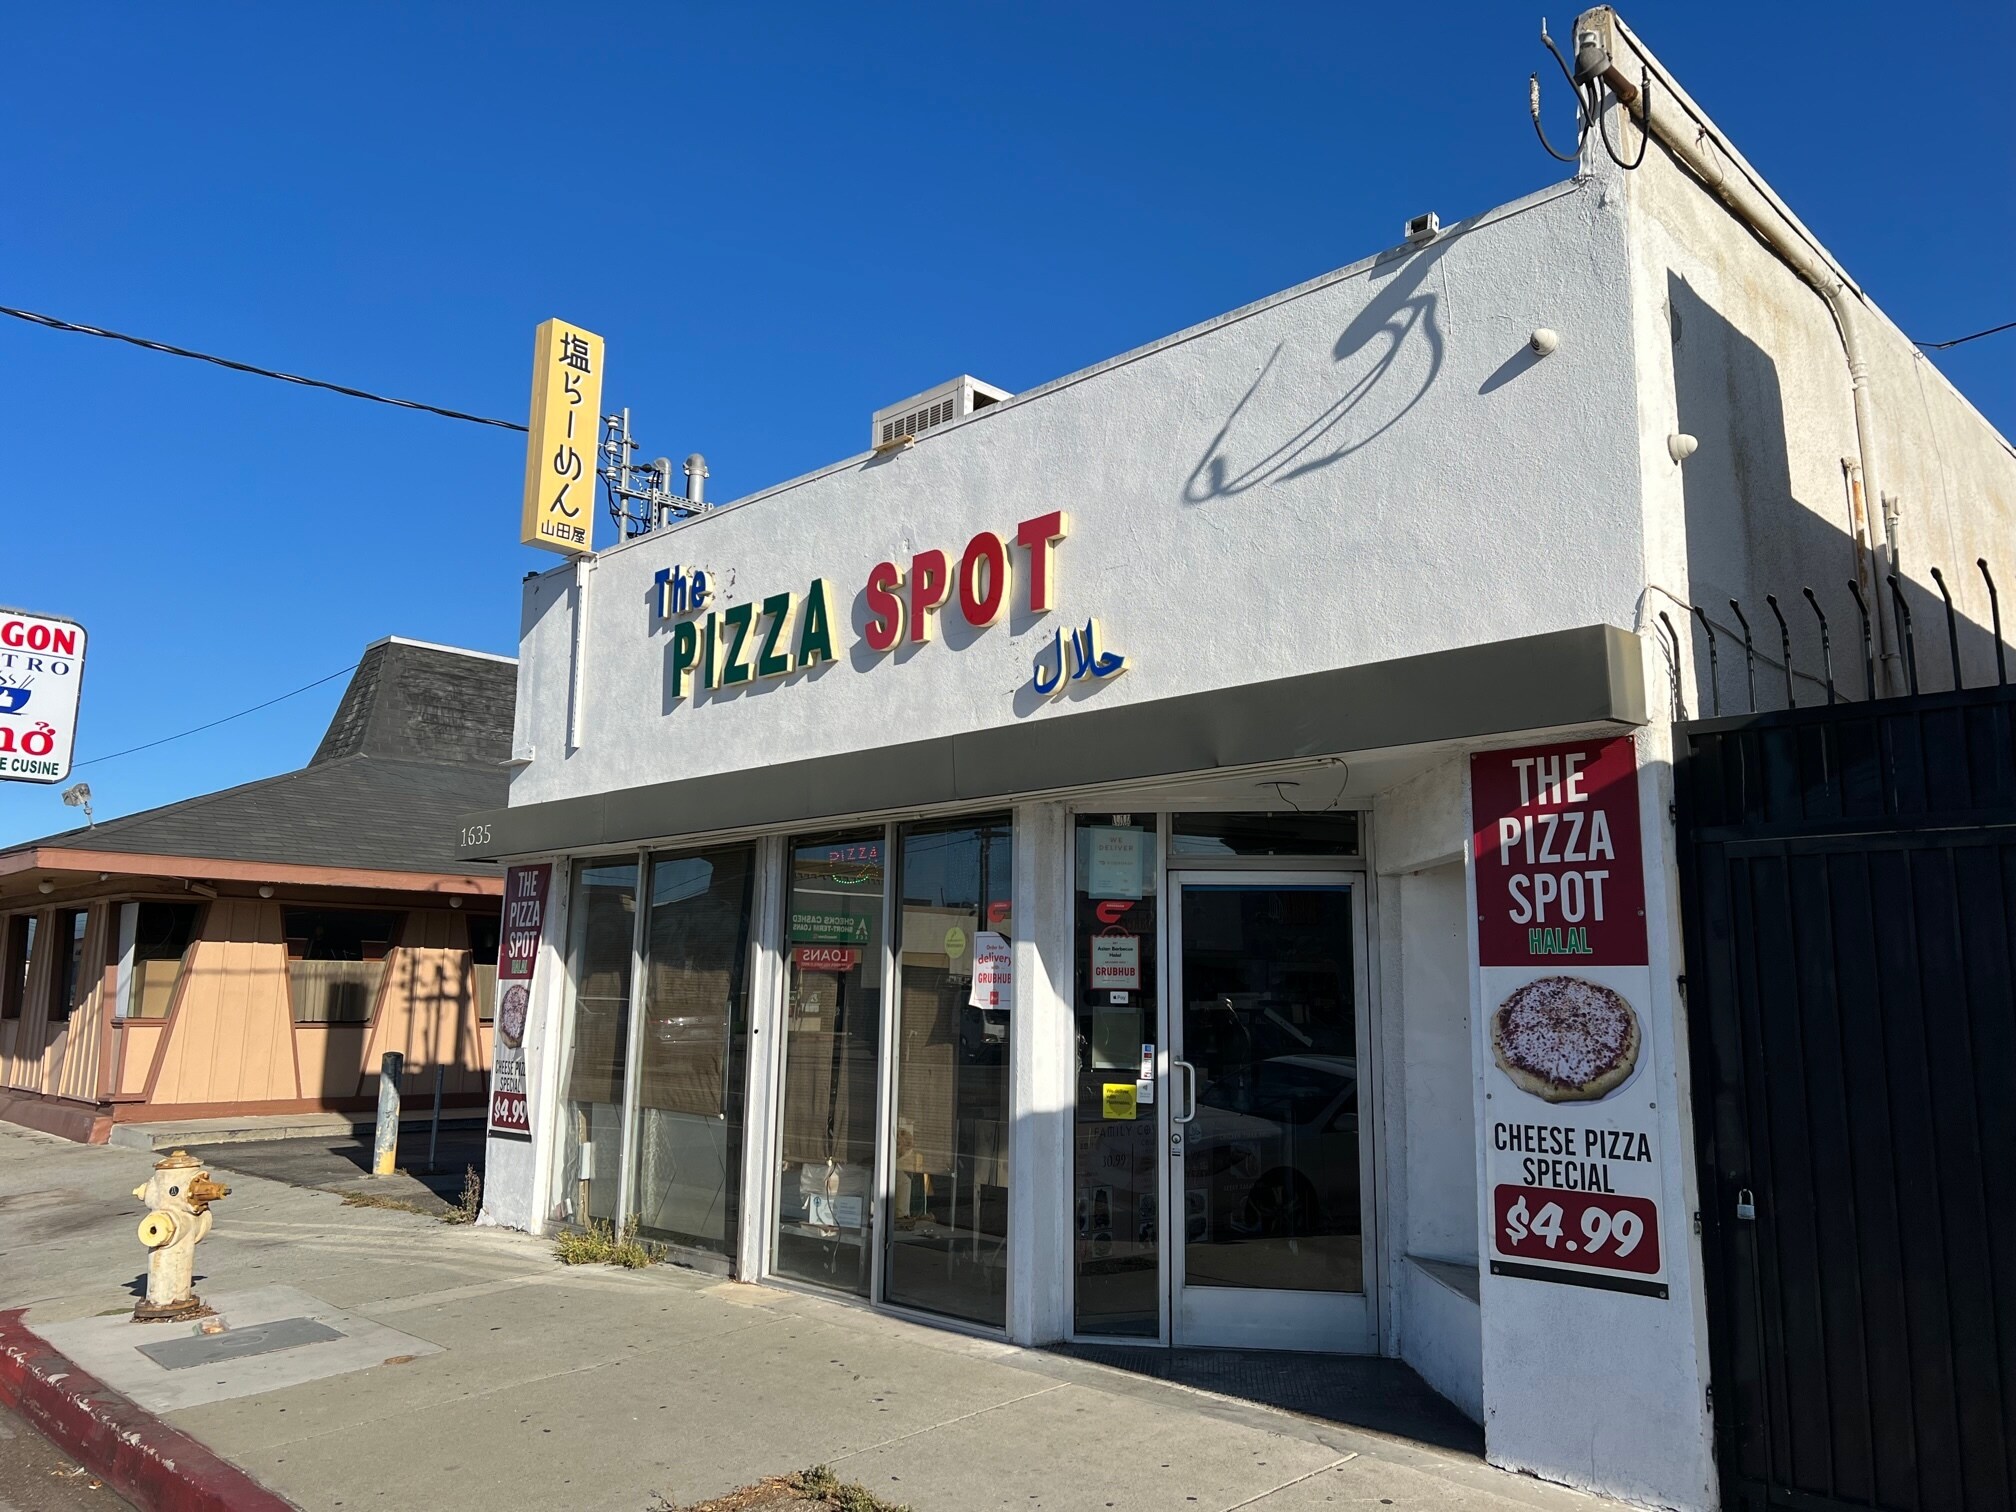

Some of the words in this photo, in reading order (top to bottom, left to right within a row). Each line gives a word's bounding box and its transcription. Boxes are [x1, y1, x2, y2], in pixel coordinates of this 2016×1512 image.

[548, 331, 591, 518] 塩らーめん
[540, 519, 586, 545] 山田屋
[654, 564, 715, 619] The
[671, 577, 839, 698] PIZZA
[864, 510, 1069, 651] SPOT
[0, 620, 76, 656] GON
[1033, 616, 1131, 696] حلال
[11, 758, 60, 776] CUSINE
[1511, 752, 1589, 807] THE
[460, 823, 492, 847] 1635
[1098, 844, 1134, 852] DELIVER
[1498, 809, 1616, 866] PIZZA
[828, 846, 878, 867] PIZZA
[518, 870, 539, 898] THE
[1507, 869, 1610, 925] SPOT
[509, 900, 540, 928] PIZZA
[508, 930, 537, 959] SPOT
[1528, 926, 1593, 955] HALAL
[978, 951, 1012, 967] delivery
[1095, 966, 1136, 977] GRUBHUB
[978, 972, 1012, 984] GRUBHUB
[495, 1059, 514, 1076] CHEESE
[499, 1076, 521, 1093] SPECIAL
[493, 1095, 528, 1125] $4.99
[1493, 1122, 1577, 1157] CHEESE
[1584, 1128, 1653, 1163] PIZZA
[1522, 1156, 1616, 1194] SPECIAL
[1504, 1194, 1645, 1258] $4.99
